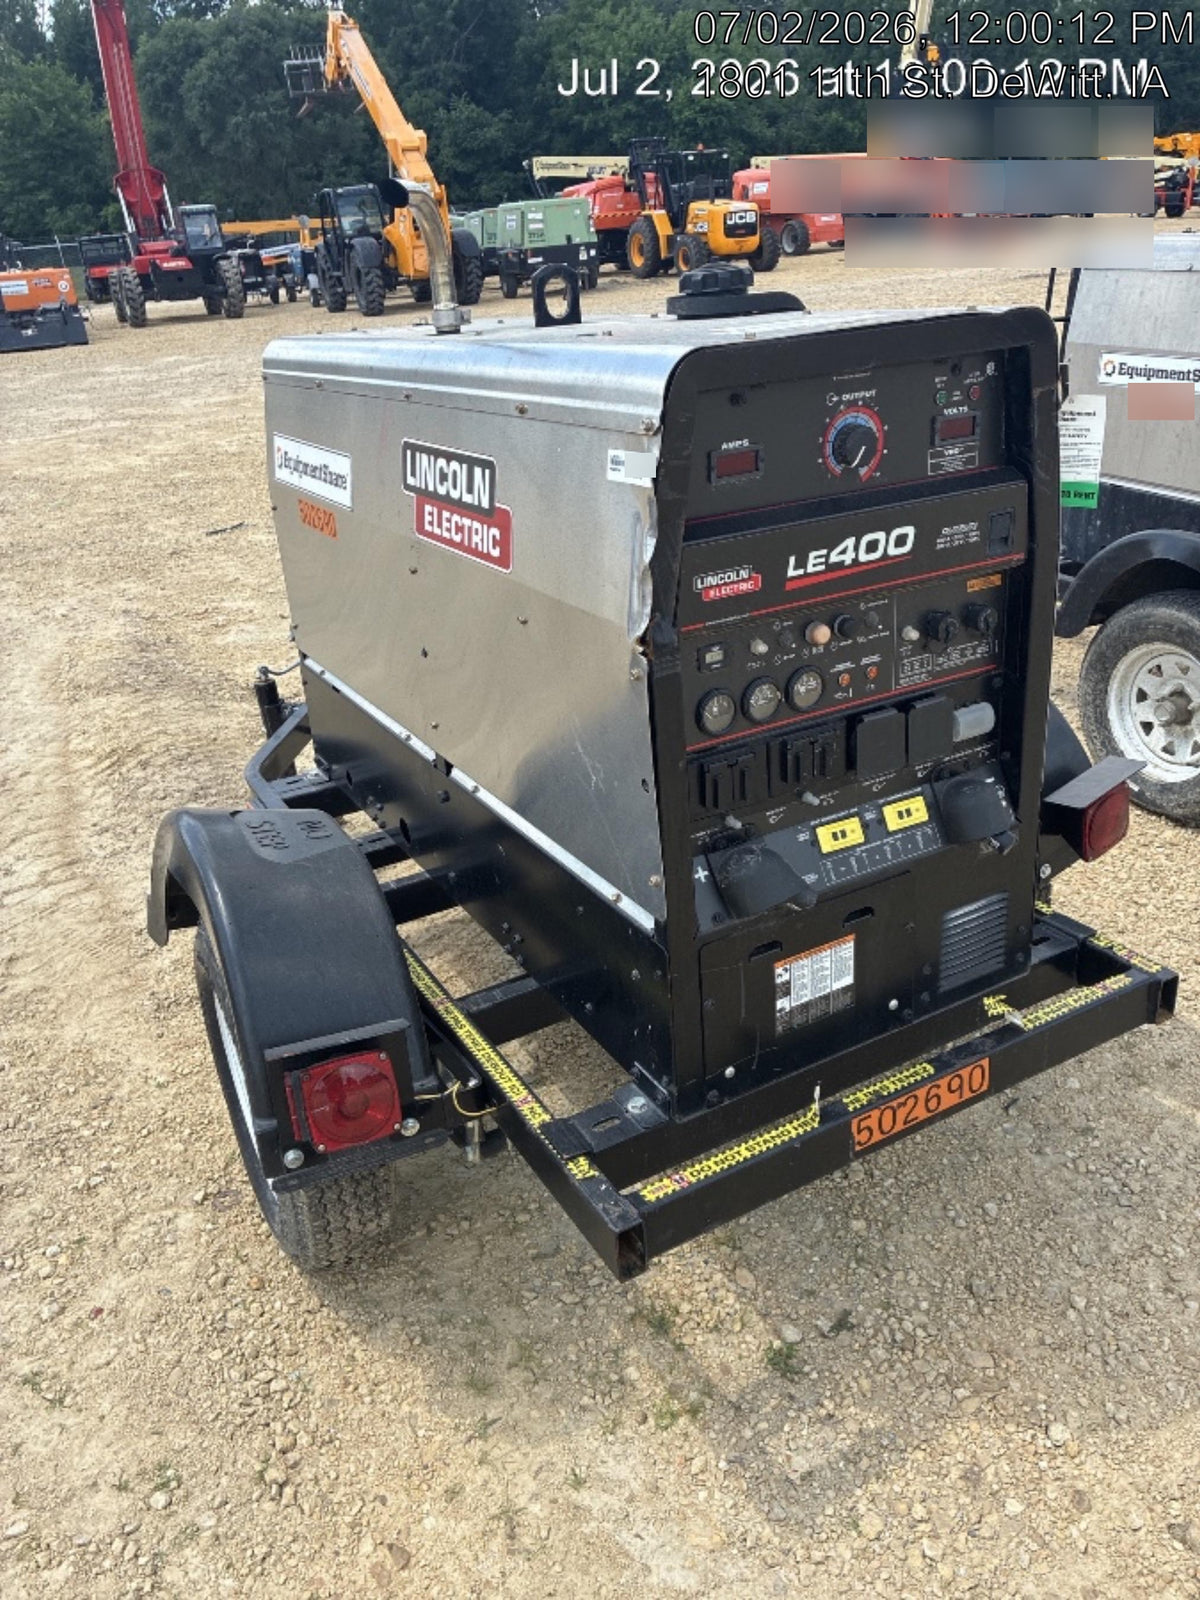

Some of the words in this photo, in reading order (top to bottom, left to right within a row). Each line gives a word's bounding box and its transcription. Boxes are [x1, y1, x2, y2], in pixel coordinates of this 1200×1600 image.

[726, 211, 756, 225] JCB
[842, 388, 877, 401] OUTPUT
[943, 405, 968, 415] VOLTS
[721, 438, 749, 450] AMPS
[406, 449, 490, 509] LINCOLN
[424, 503, 501, 557] ELECTRIC
[787, 525, 916, 577] LE400
[696, 568, 750, 588] LINCOLN
[708, 580, 755, 598] ELECTRIC
[856, 1064, 986, 1147] 502690
[690, 1163, 713, 1178] DO
[713, 1150, 744, 1167] NOT
[749, 1130, 791, 1154] STAND
